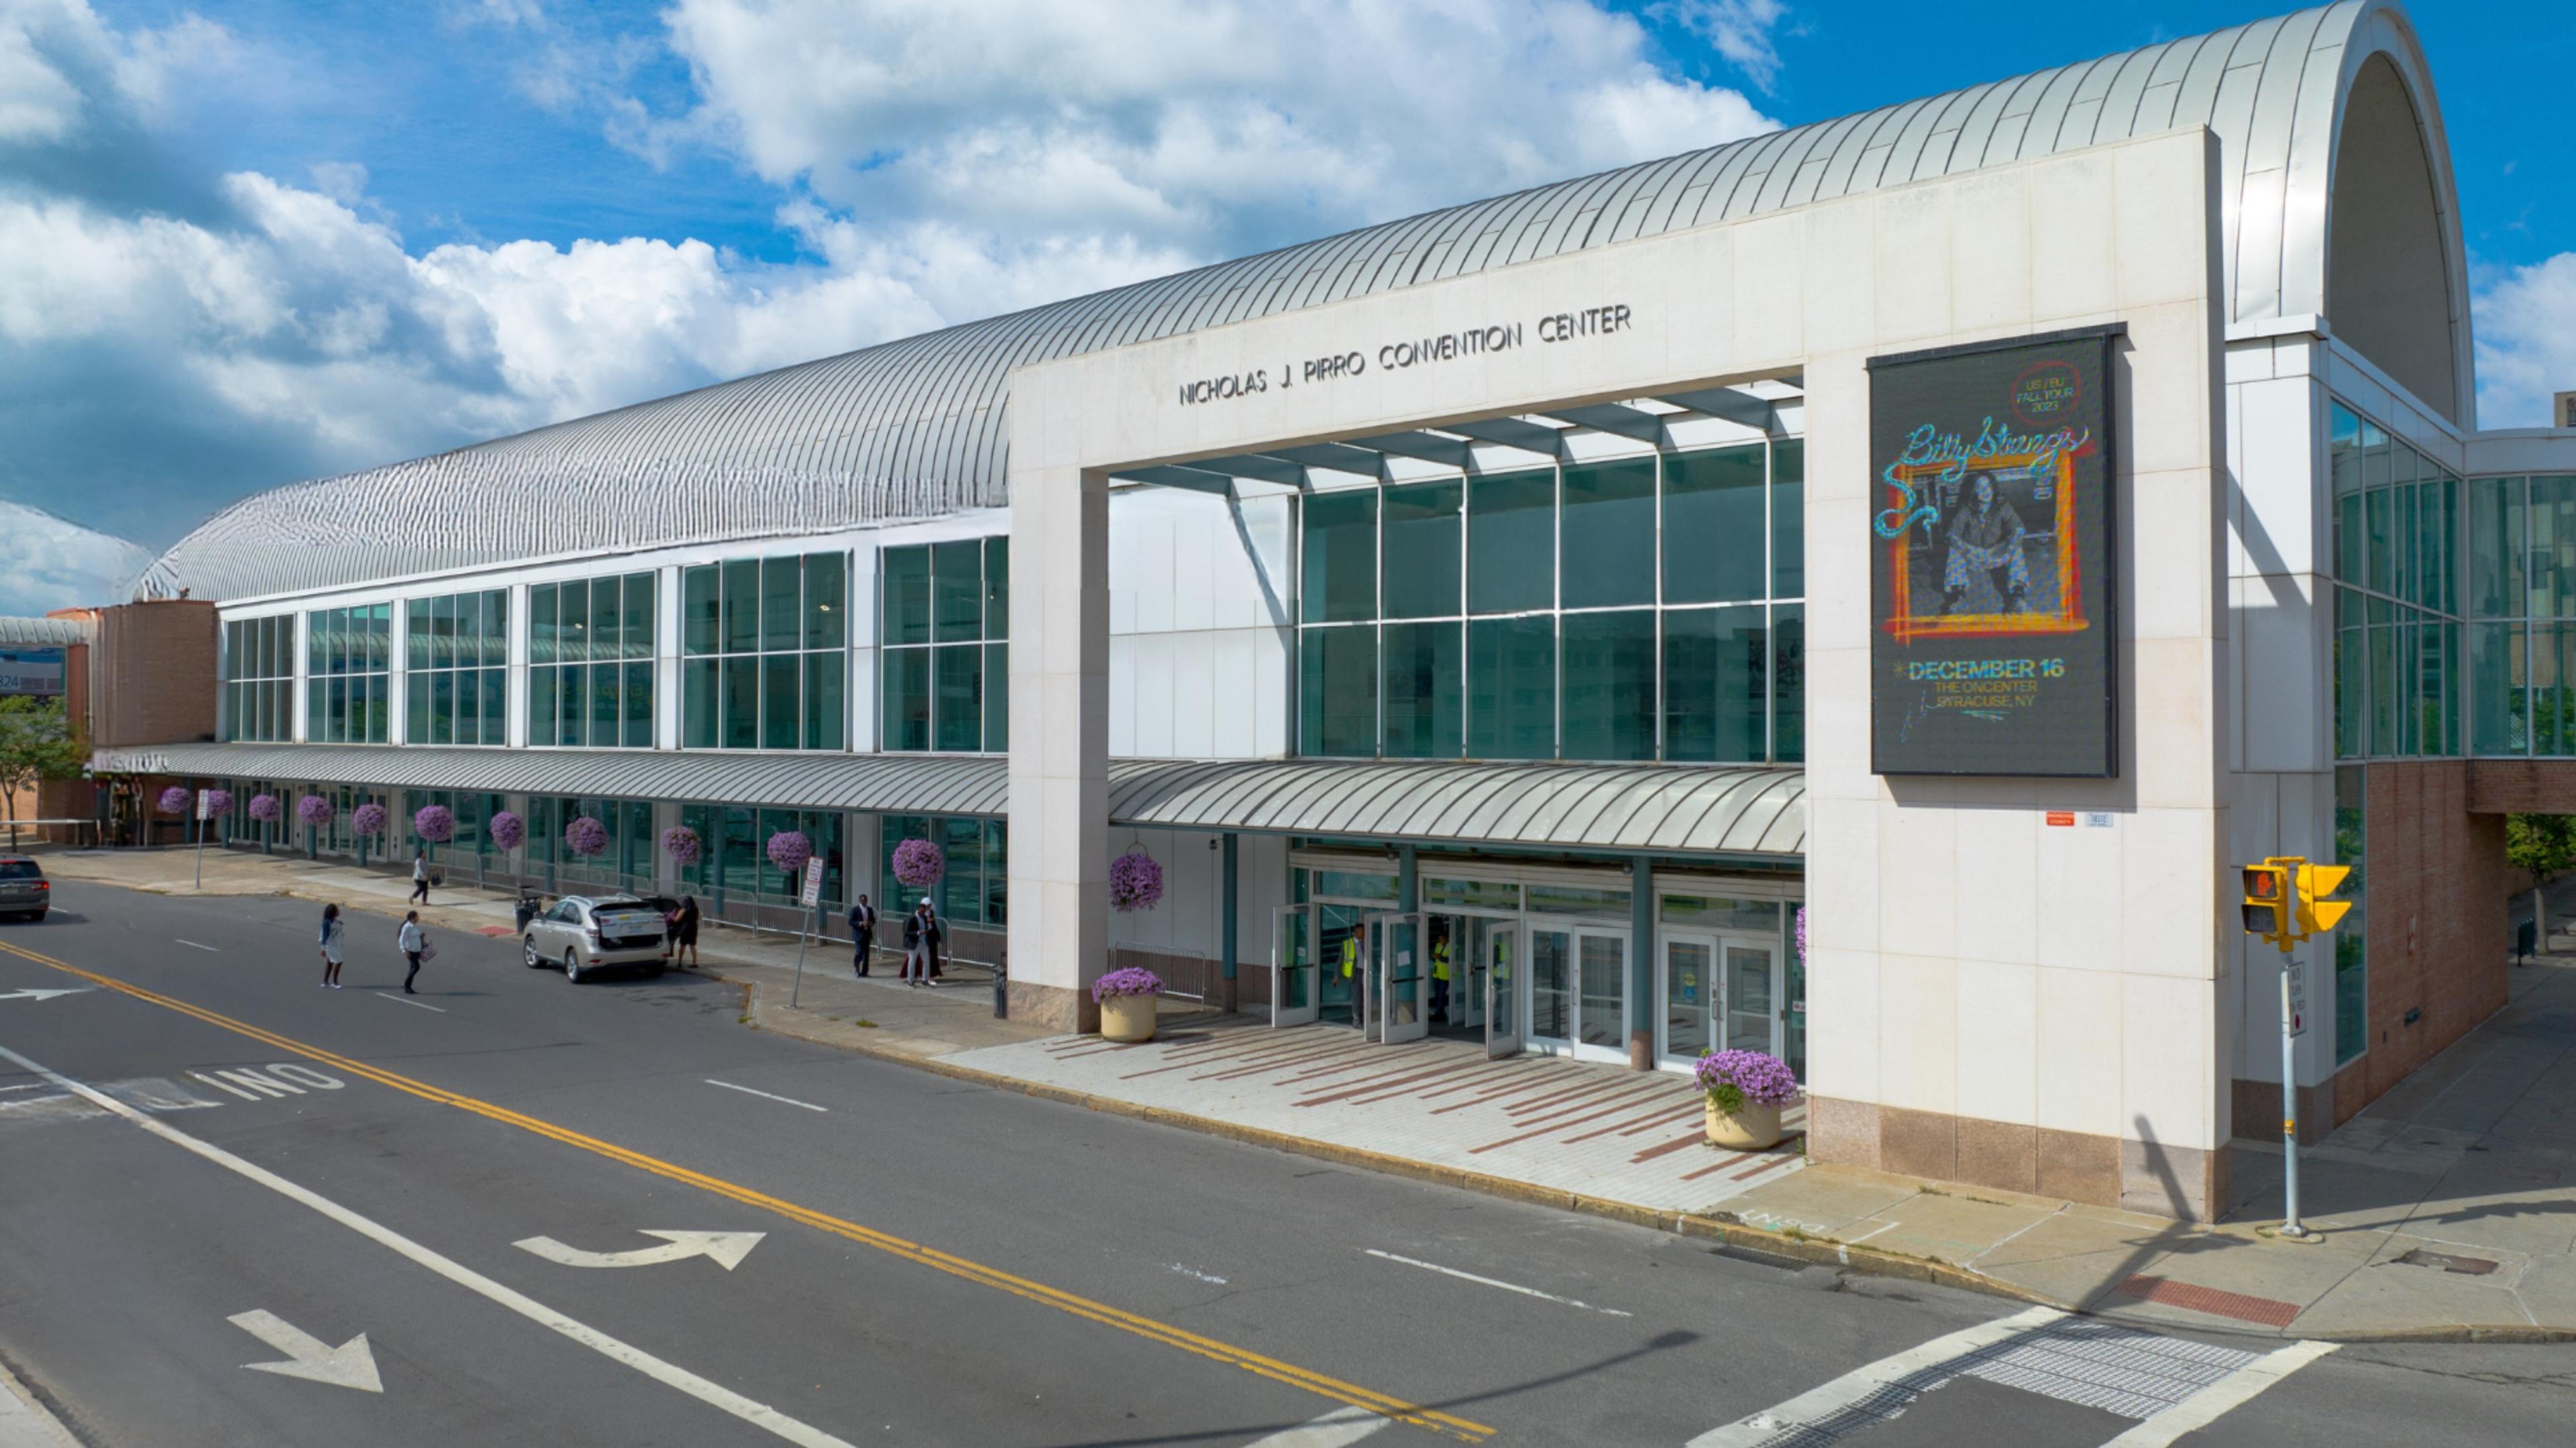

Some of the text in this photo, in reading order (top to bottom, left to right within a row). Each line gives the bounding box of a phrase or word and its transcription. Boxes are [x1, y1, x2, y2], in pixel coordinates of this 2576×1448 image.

[1179, 304, 1631, 406] NICHOLAS J. PIRRO CONVENTION CENTER
[2017, 387, 2075, 404] FALL TOUR
[2032, 400, 2059, 412] 2023
[1900, 424, 1972, 482] Billy
[1909, 658, 2065, 680] DECEMBER 16
[1935, 680, 2038, 693] THE ONCENTER
[1937, 694, 2035, 708] SYRACUSE, NY
